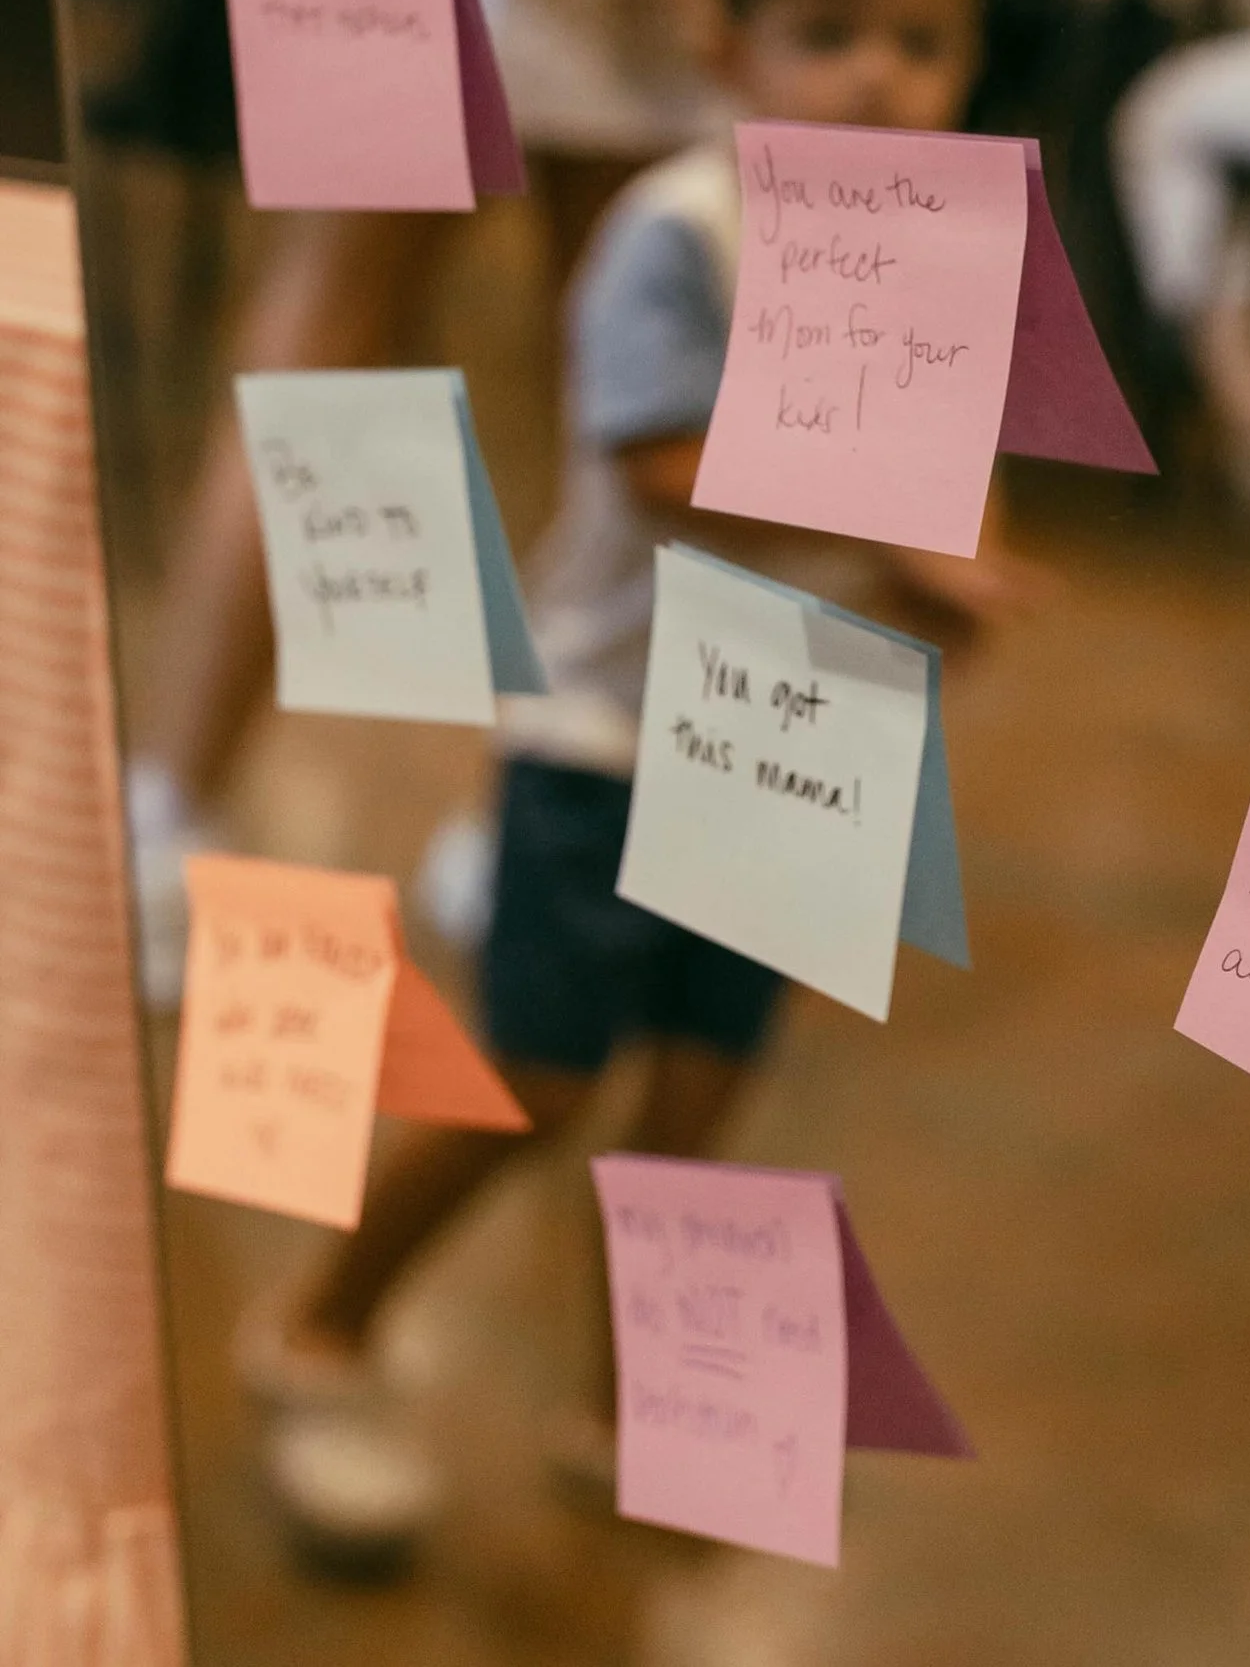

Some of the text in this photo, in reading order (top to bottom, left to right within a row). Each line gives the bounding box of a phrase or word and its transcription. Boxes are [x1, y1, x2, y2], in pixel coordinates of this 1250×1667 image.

[753, 144, 947, 246] You are the
[780, 233, 897, 284] perfect
[843, 301, 887, 349] for
[896, 326, 970, 389] your
[698, 638, 831, 732] You got
[669, 712, 862, 827] this mama!
